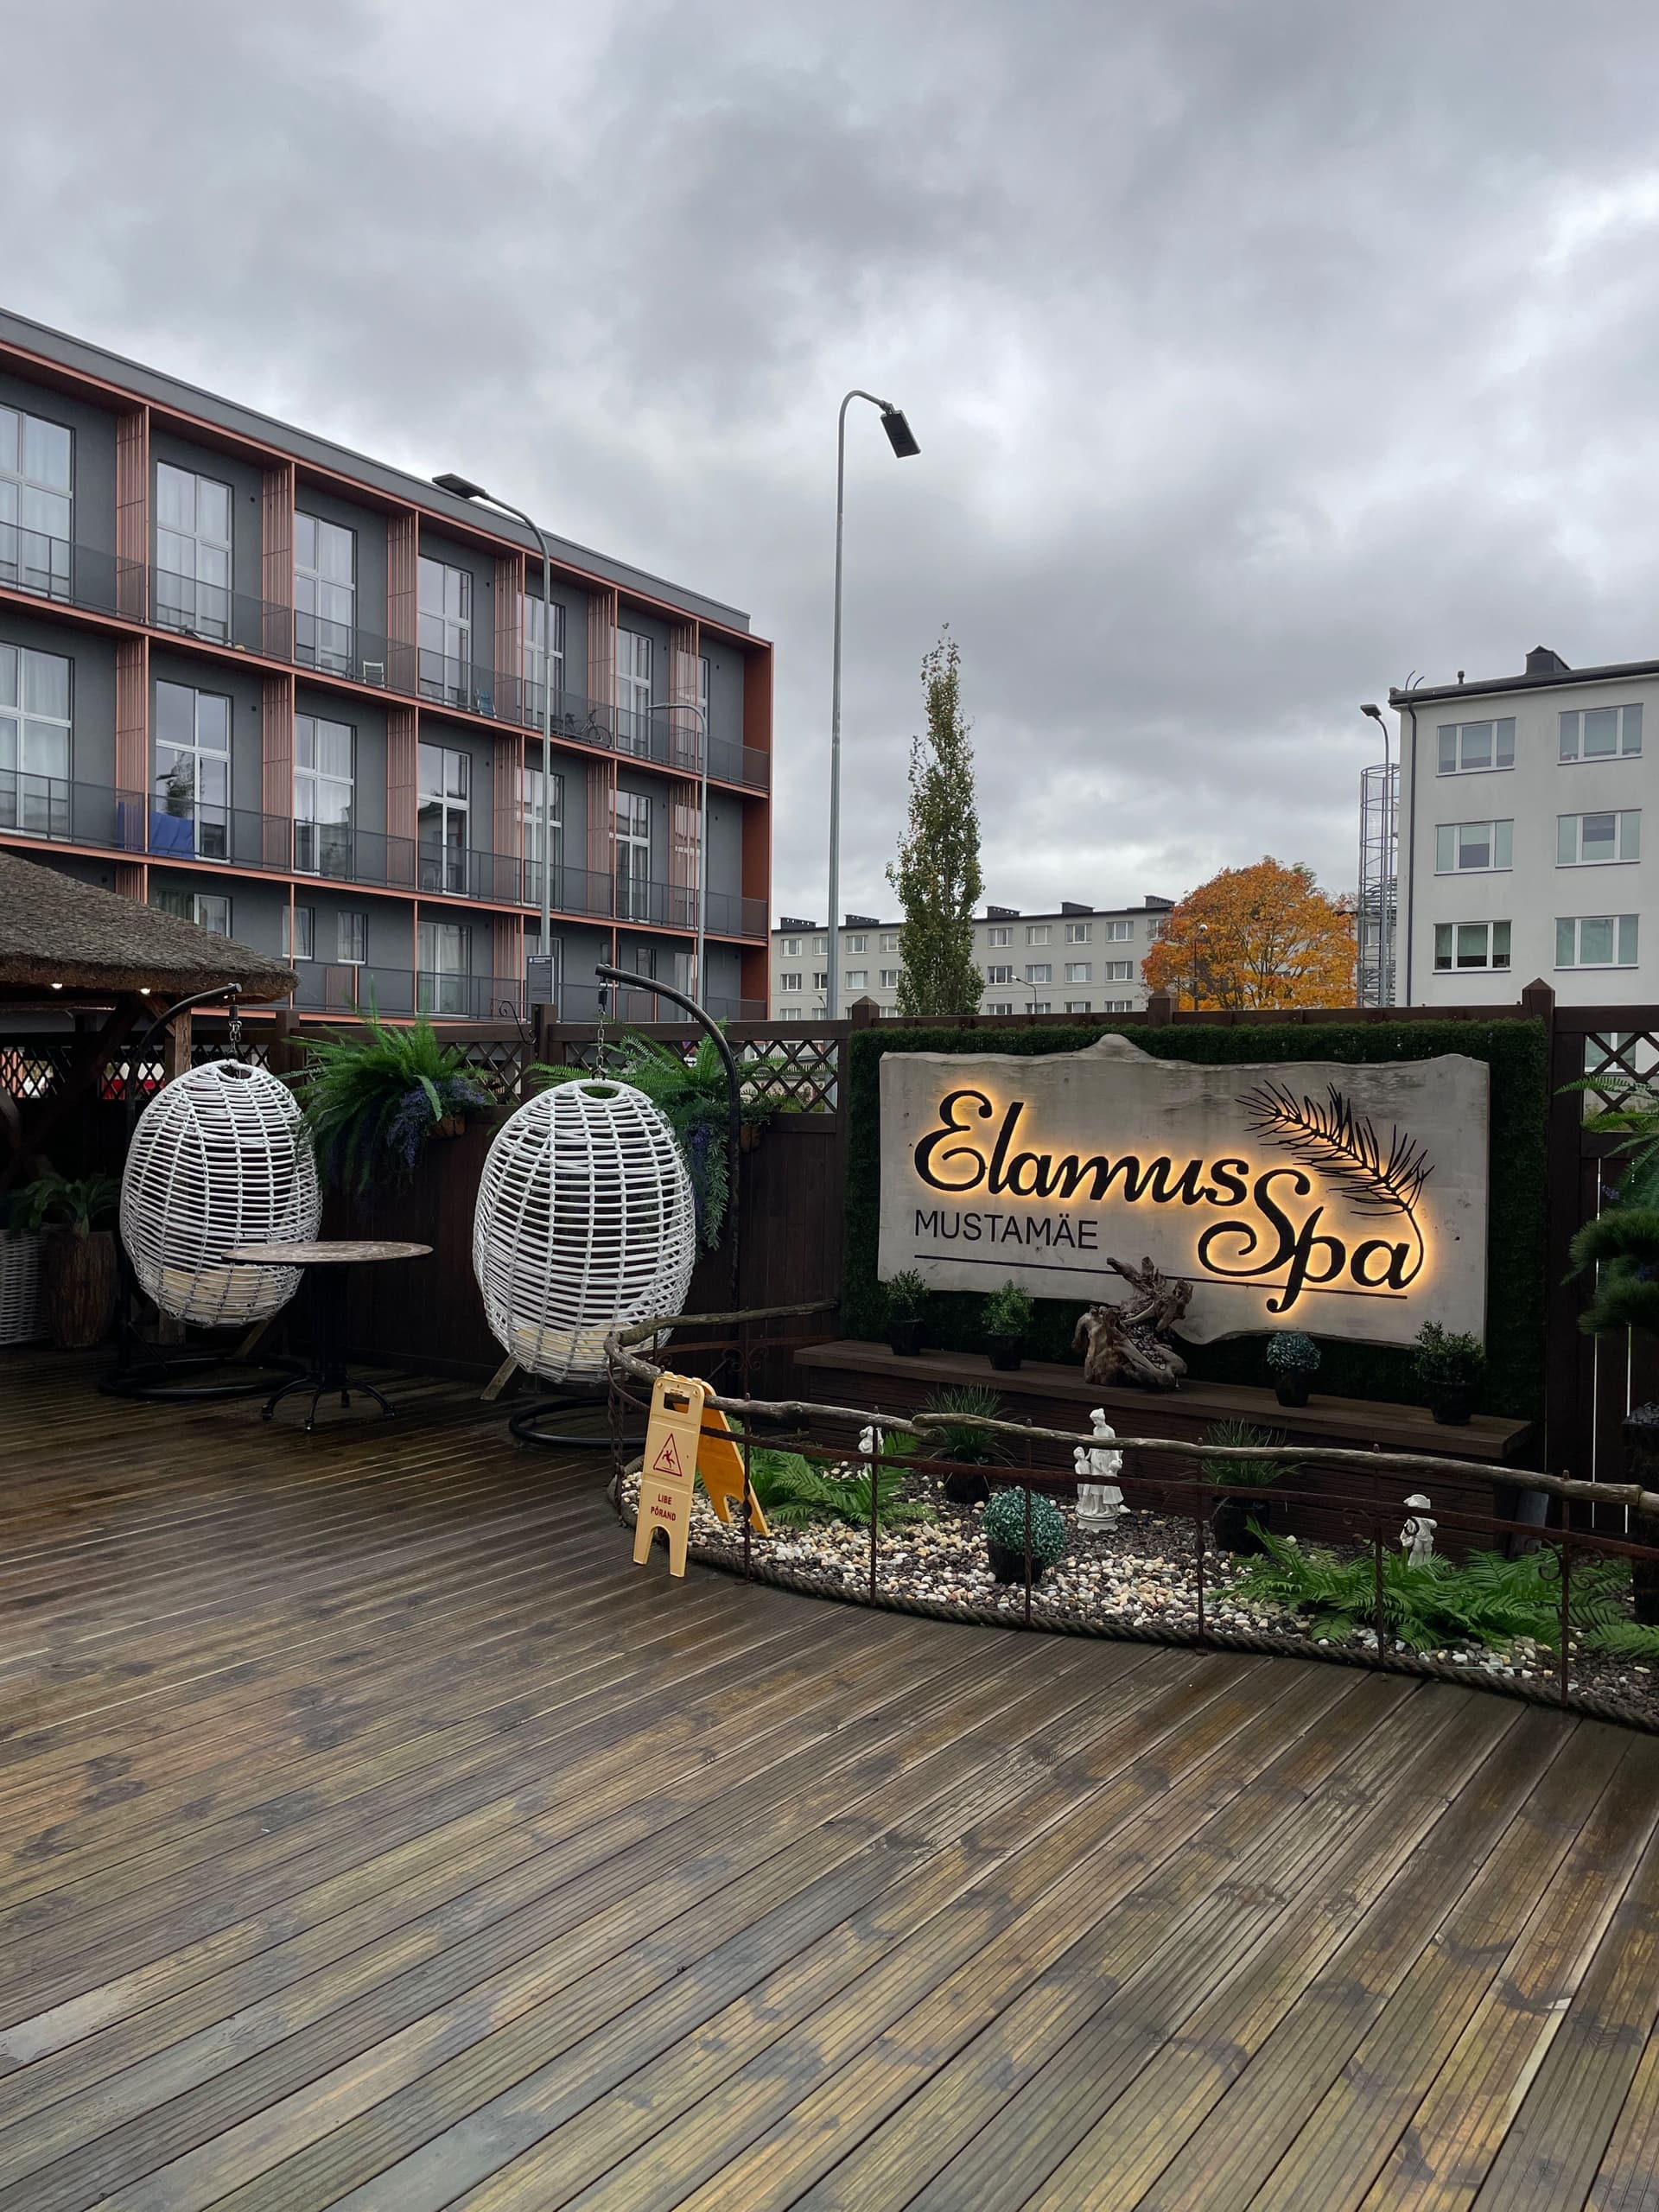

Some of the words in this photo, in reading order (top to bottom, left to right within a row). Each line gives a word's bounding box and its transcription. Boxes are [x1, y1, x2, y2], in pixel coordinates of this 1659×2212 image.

[913, 1090, 1249, 1206] Elamus
[1198, 1169, 1420, 1314] Spa
[915, 1211, 1098, 1250] MUSTAMÄE
[658, 1493, 672, 1505] LIBE
